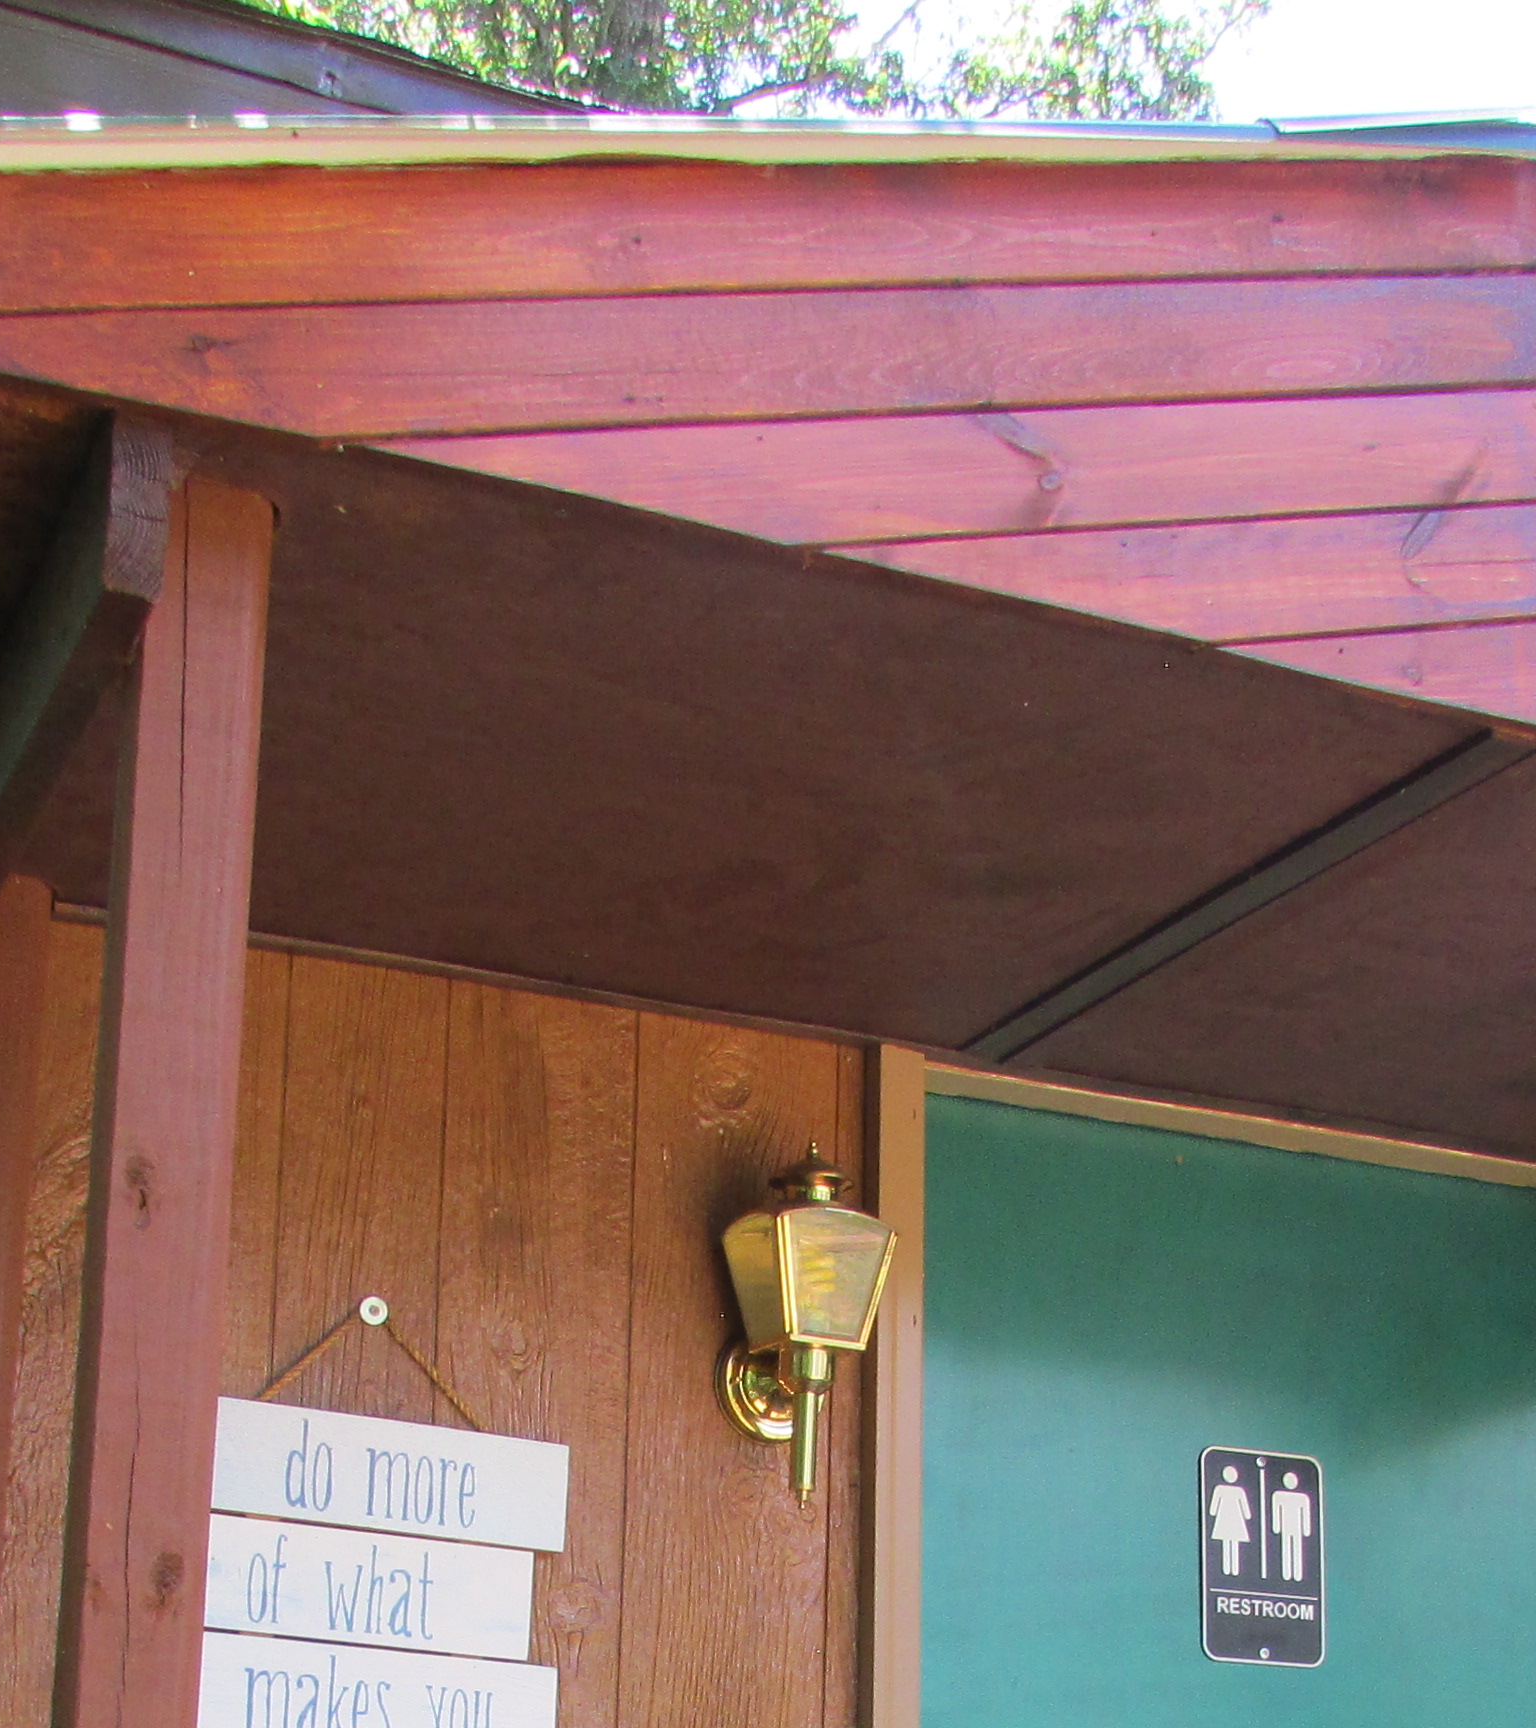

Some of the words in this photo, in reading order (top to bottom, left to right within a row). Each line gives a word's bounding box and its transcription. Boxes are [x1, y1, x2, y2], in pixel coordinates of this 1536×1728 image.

[284, 1417, 333, 1512] do
[365, 1447, 476, 1529] more
[246, 1533, 289, 1625] of
[324, 1544, 434, 1641] what
[1216, 1596, 1315, 1621] RESTROOM
